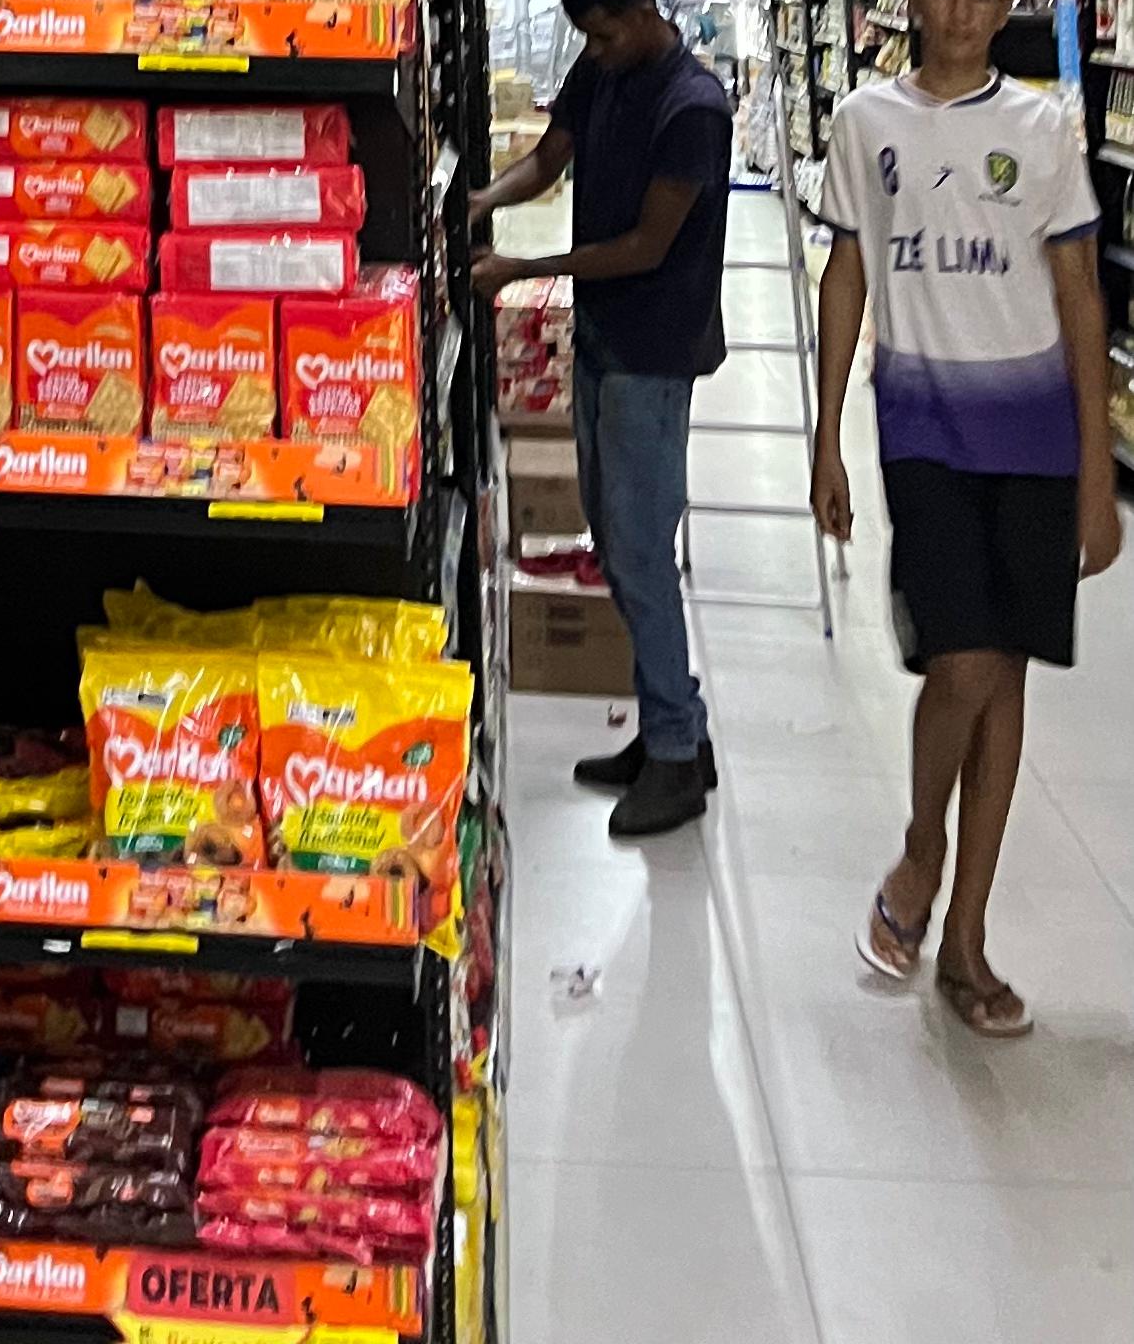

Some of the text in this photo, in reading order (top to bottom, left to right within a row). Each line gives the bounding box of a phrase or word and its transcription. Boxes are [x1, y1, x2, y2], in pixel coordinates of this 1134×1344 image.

[26, 339, 132, 377] Marilan
[159, 342, 265, 380] Marilan
[296, 352, 404, 390] Marilan
[141, 1265, 279, 1313] OFERTA
